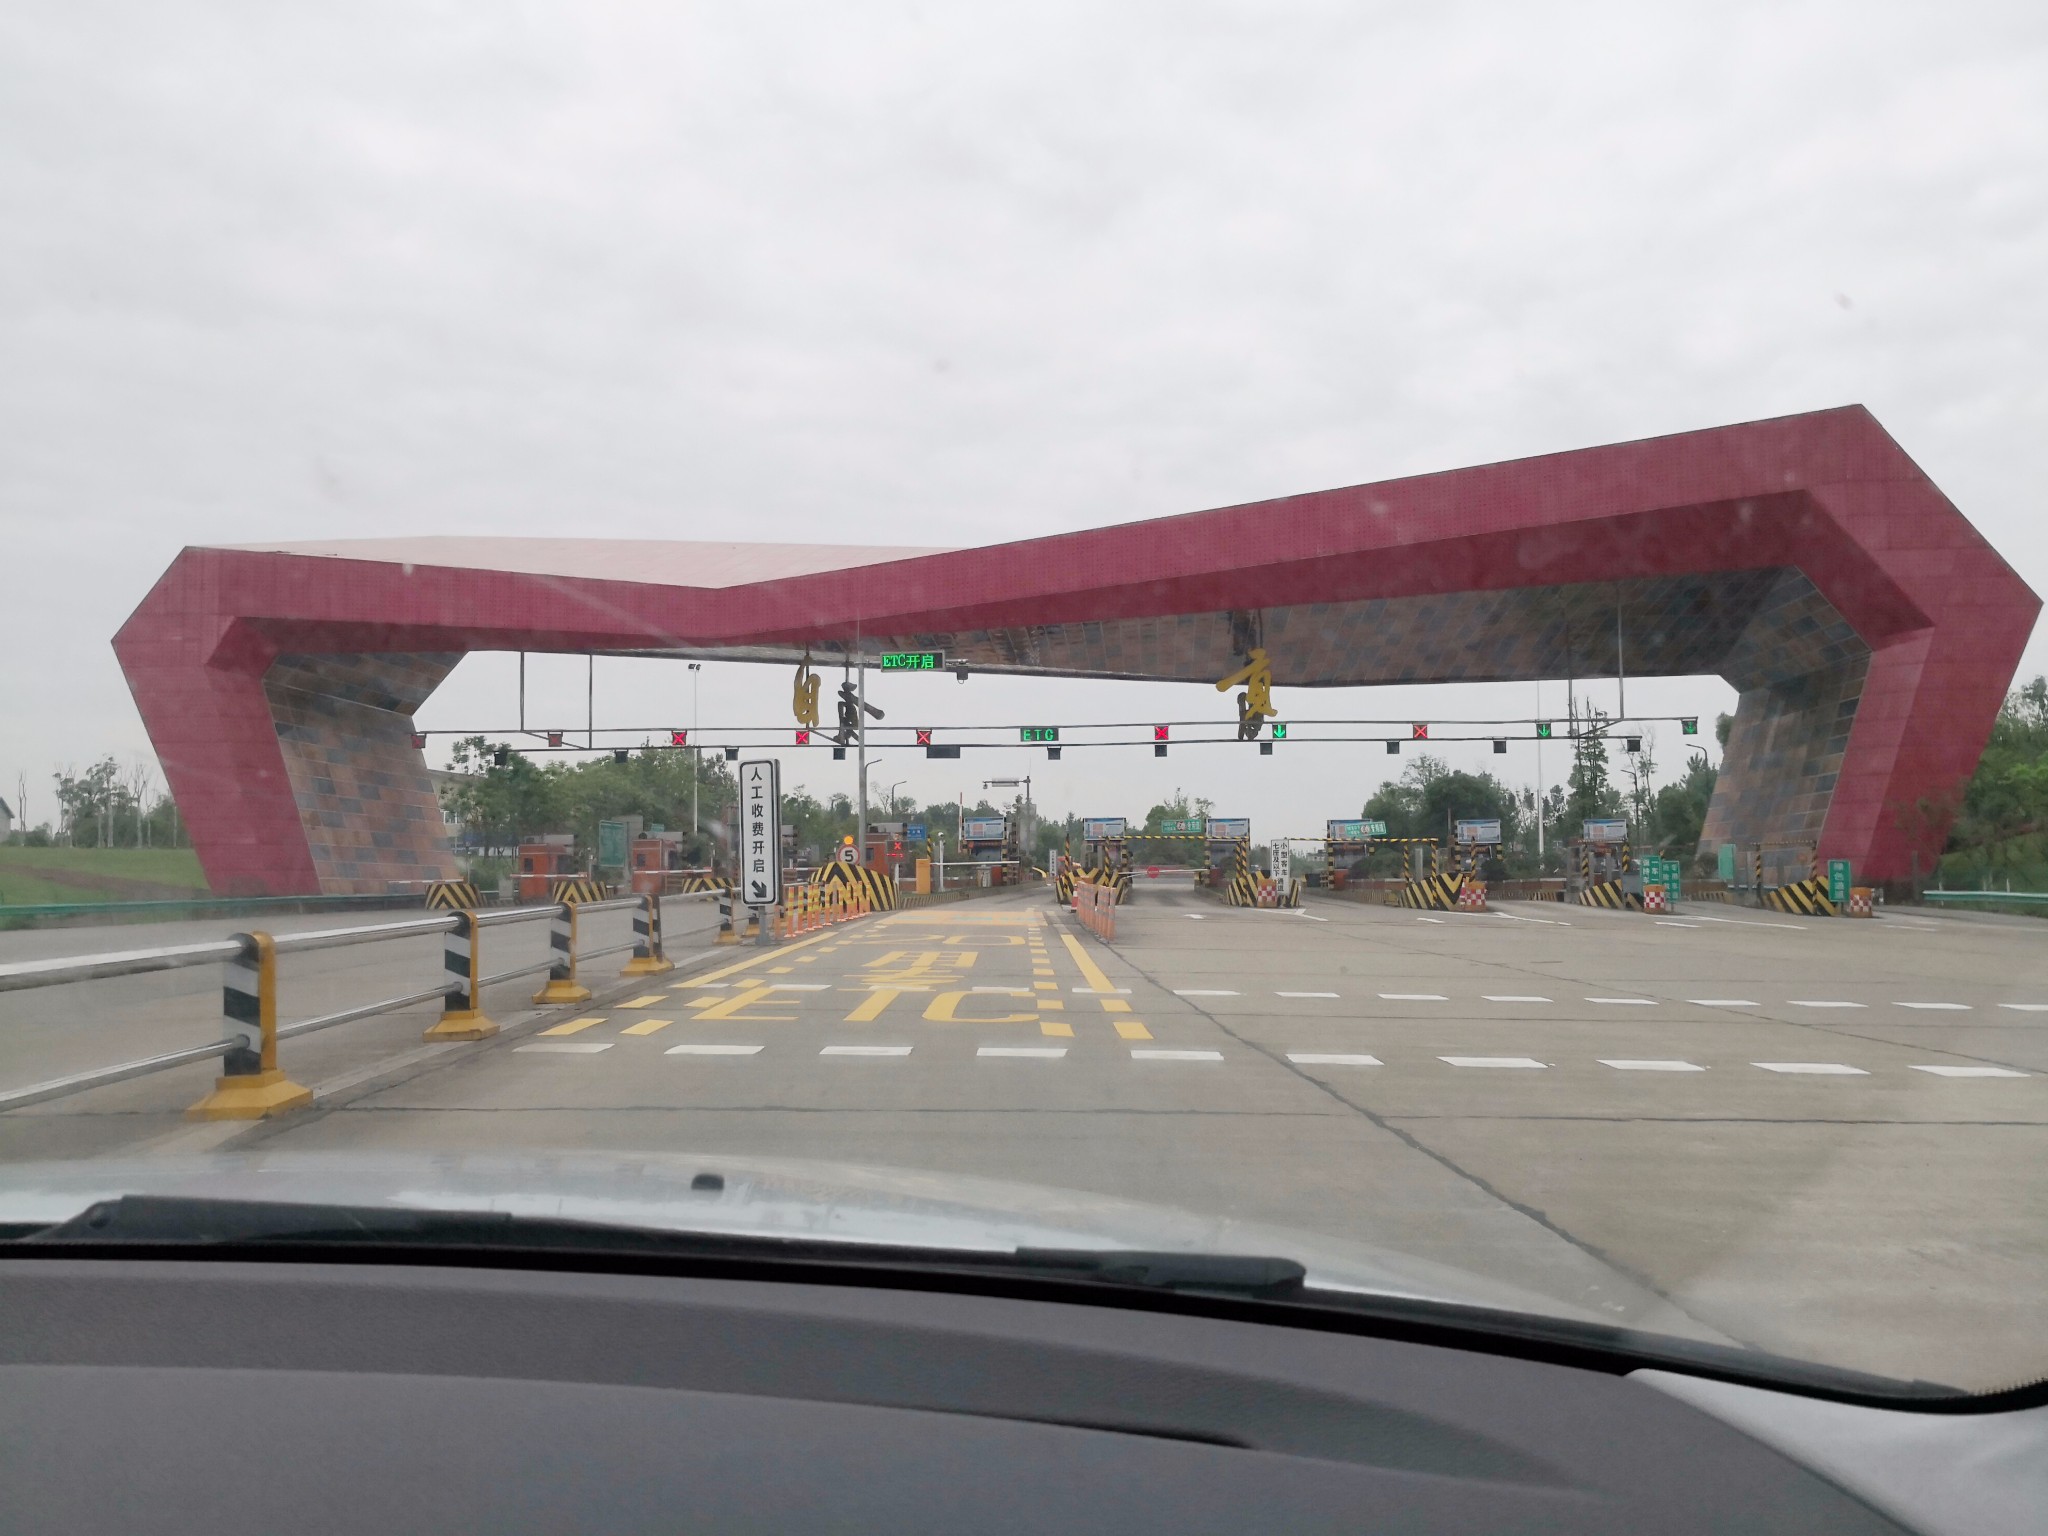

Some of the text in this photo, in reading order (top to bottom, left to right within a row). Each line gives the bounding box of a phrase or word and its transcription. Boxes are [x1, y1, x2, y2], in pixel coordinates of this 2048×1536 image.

[882, 654, 935, 670] ETC开启
[1023, 728, 1054, 741] ETC
[750, 766, 765, 873] 人工收费开启
[844, 850, 855, 863] 5
[853, 934, 1026, 946] 20
[690, 987, 1041, 1023] ETC
